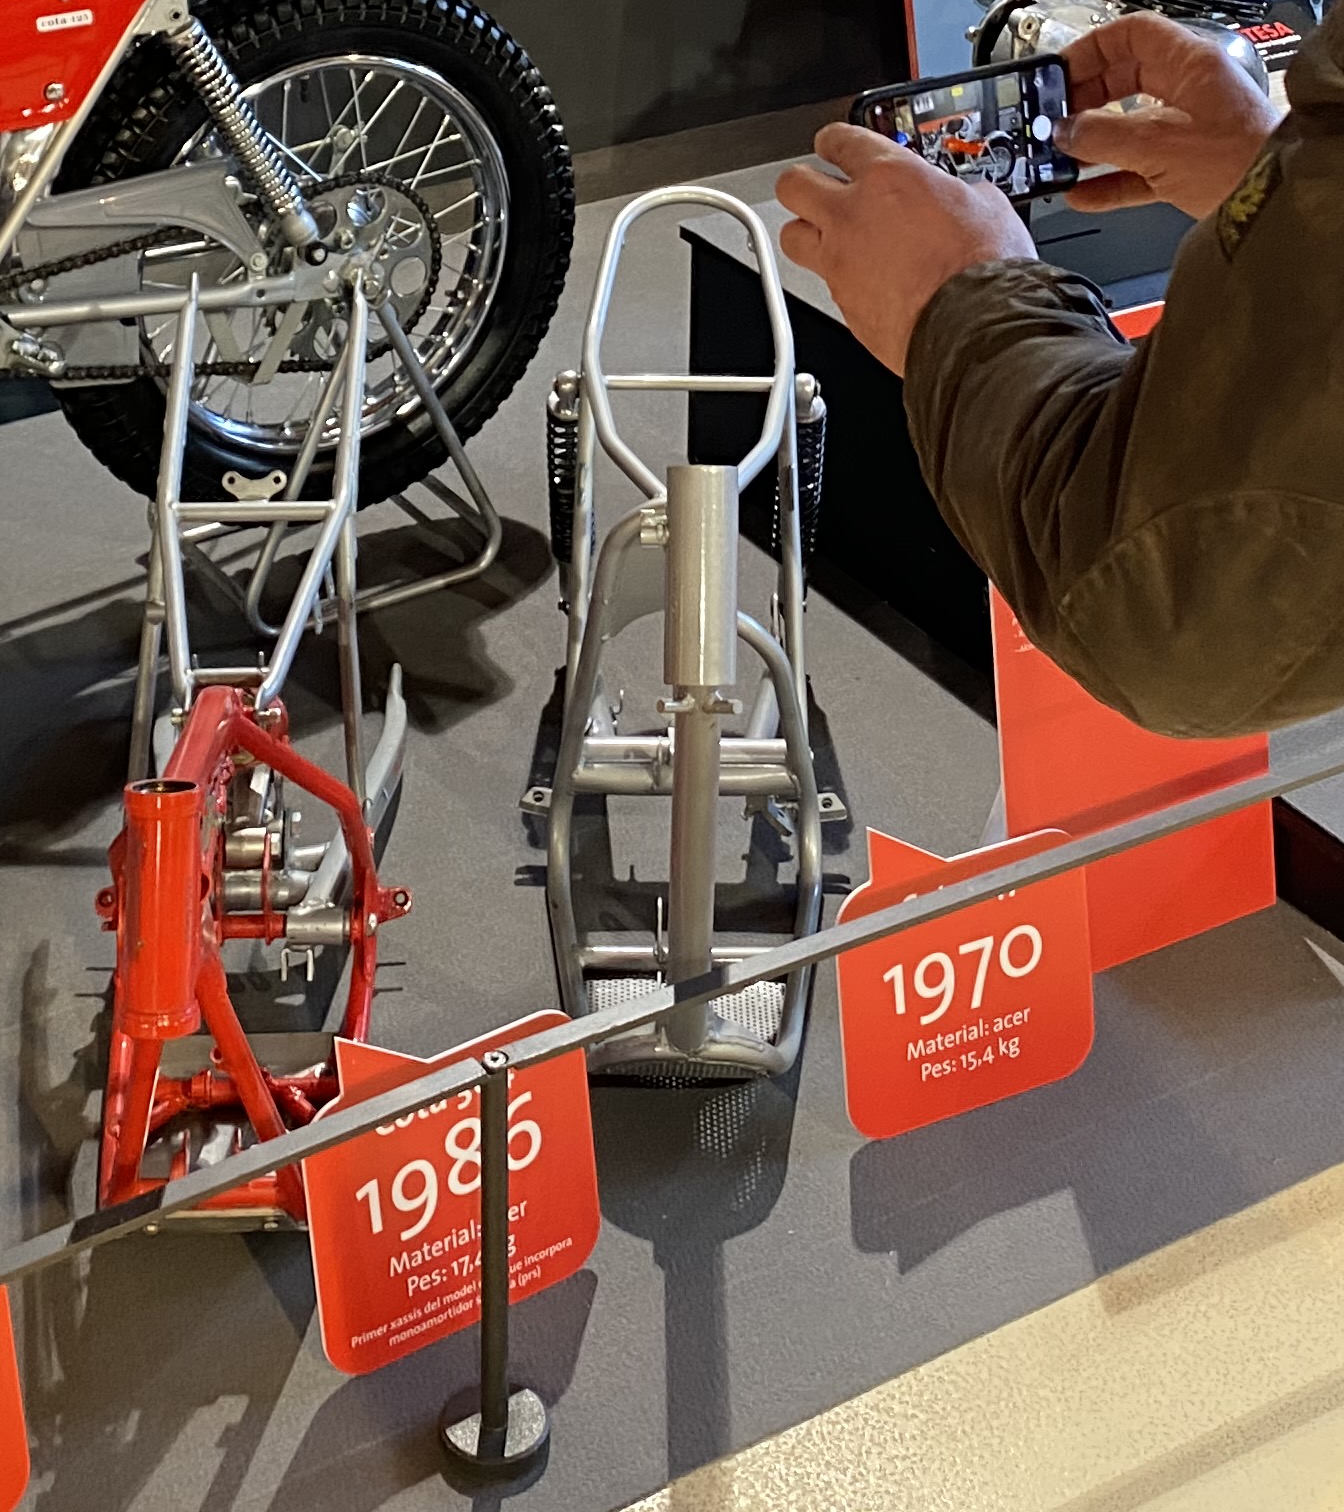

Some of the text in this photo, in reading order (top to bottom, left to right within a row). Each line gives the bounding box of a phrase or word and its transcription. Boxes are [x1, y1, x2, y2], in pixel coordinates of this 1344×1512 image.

[882, 924, 1043, 1026] 1970
[906, 1006, 1032, 1061] Material: acer
[920, 1035, 1021, 1082] Pes: 15,4 kg
[355, 1090, 543, 1242] 1986
[389, 1219, 481, 1278] Material:
[406, 1268, 448, 1297] Pes:
[350, 1323, 388, 1349] Primer
[423, 1298, 441, 1314] del
[442, 1282, 477, 1306] model
[524, 1237, 573, 1268] incorpora
[388, 1265, 542, 1347] monoamortidor (prs)
